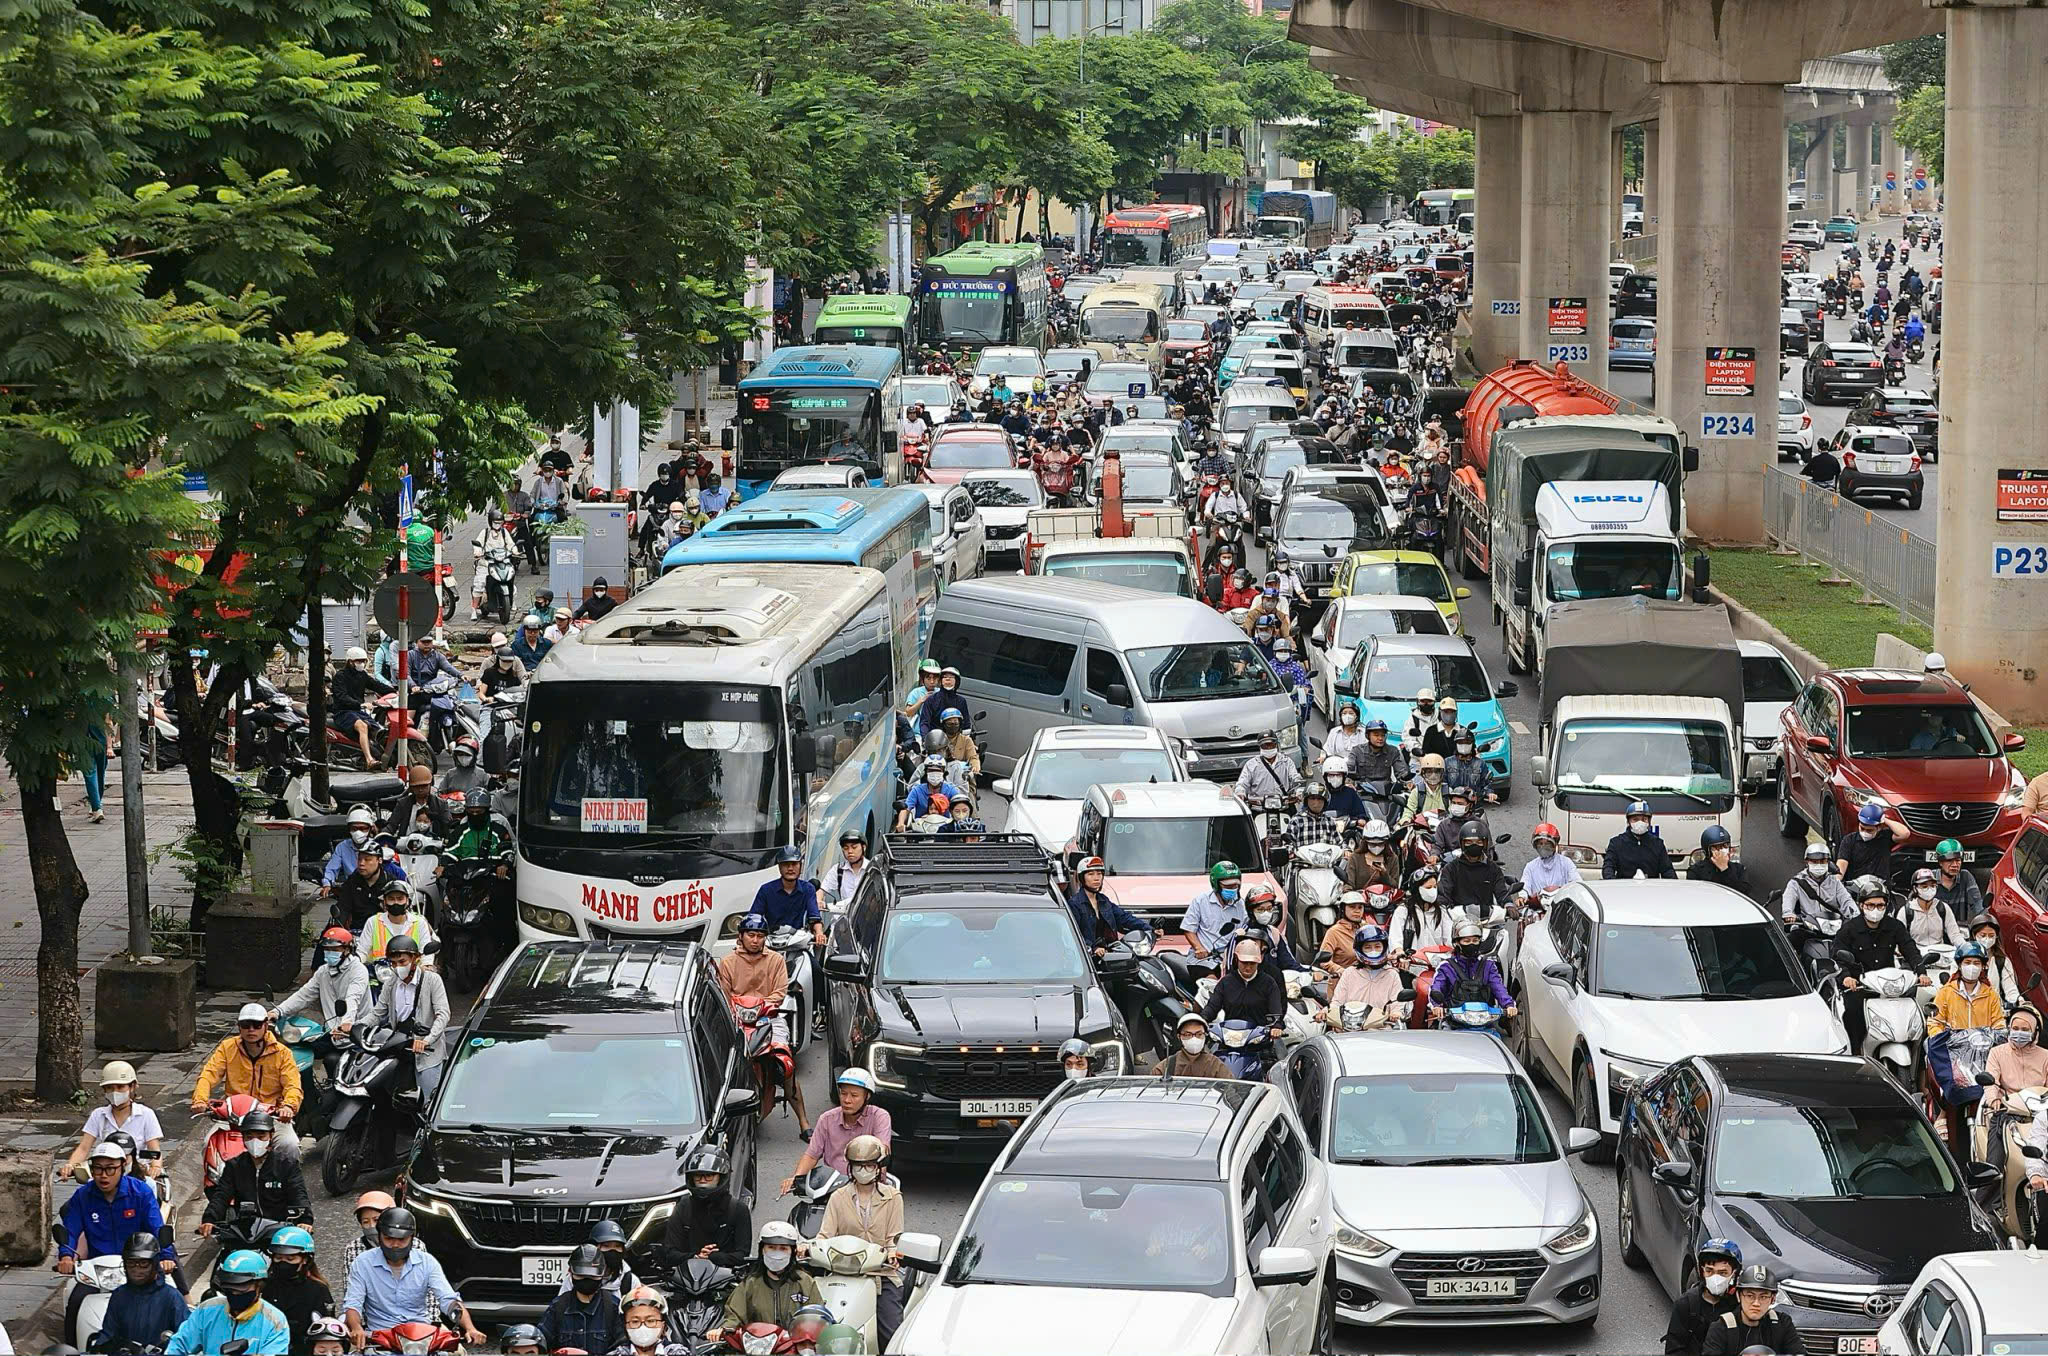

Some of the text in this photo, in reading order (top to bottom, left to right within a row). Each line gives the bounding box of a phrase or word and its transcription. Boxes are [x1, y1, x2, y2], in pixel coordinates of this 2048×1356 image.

[1493, 302, 1520, 315] P232
[853, 329, 865, 338] 13
[1549, 346, 1588, 361] P233
[1709, 361, 1751, 370] ĐIỆN THOẠI
[1728, 376, 1746, 384] KIỆN
[1703, 416, 1755, 435] P234
[2000, 484, 2048, 494] TRUNG T
[1574, 495, 1643, 503] ISUZU
[2010, 497, 2048, 506] LAPTO
[1996, 547, 2048, 574] P23
[721, 692, 730, 702] XE
[730, 692, 742, 704] HỢP
[584, 799, 646, 821] NINH BÌNH
[582, 880, 714, 922] MẠNH CHIẾN
[967, 1102, 1033, 1113] 30L-113.85
[537, 1259, 562, 1272] 30H
[528, 1272, 565, 1284] 399.4
[1434, 1280, 1509, 1294] 30K-343.14
